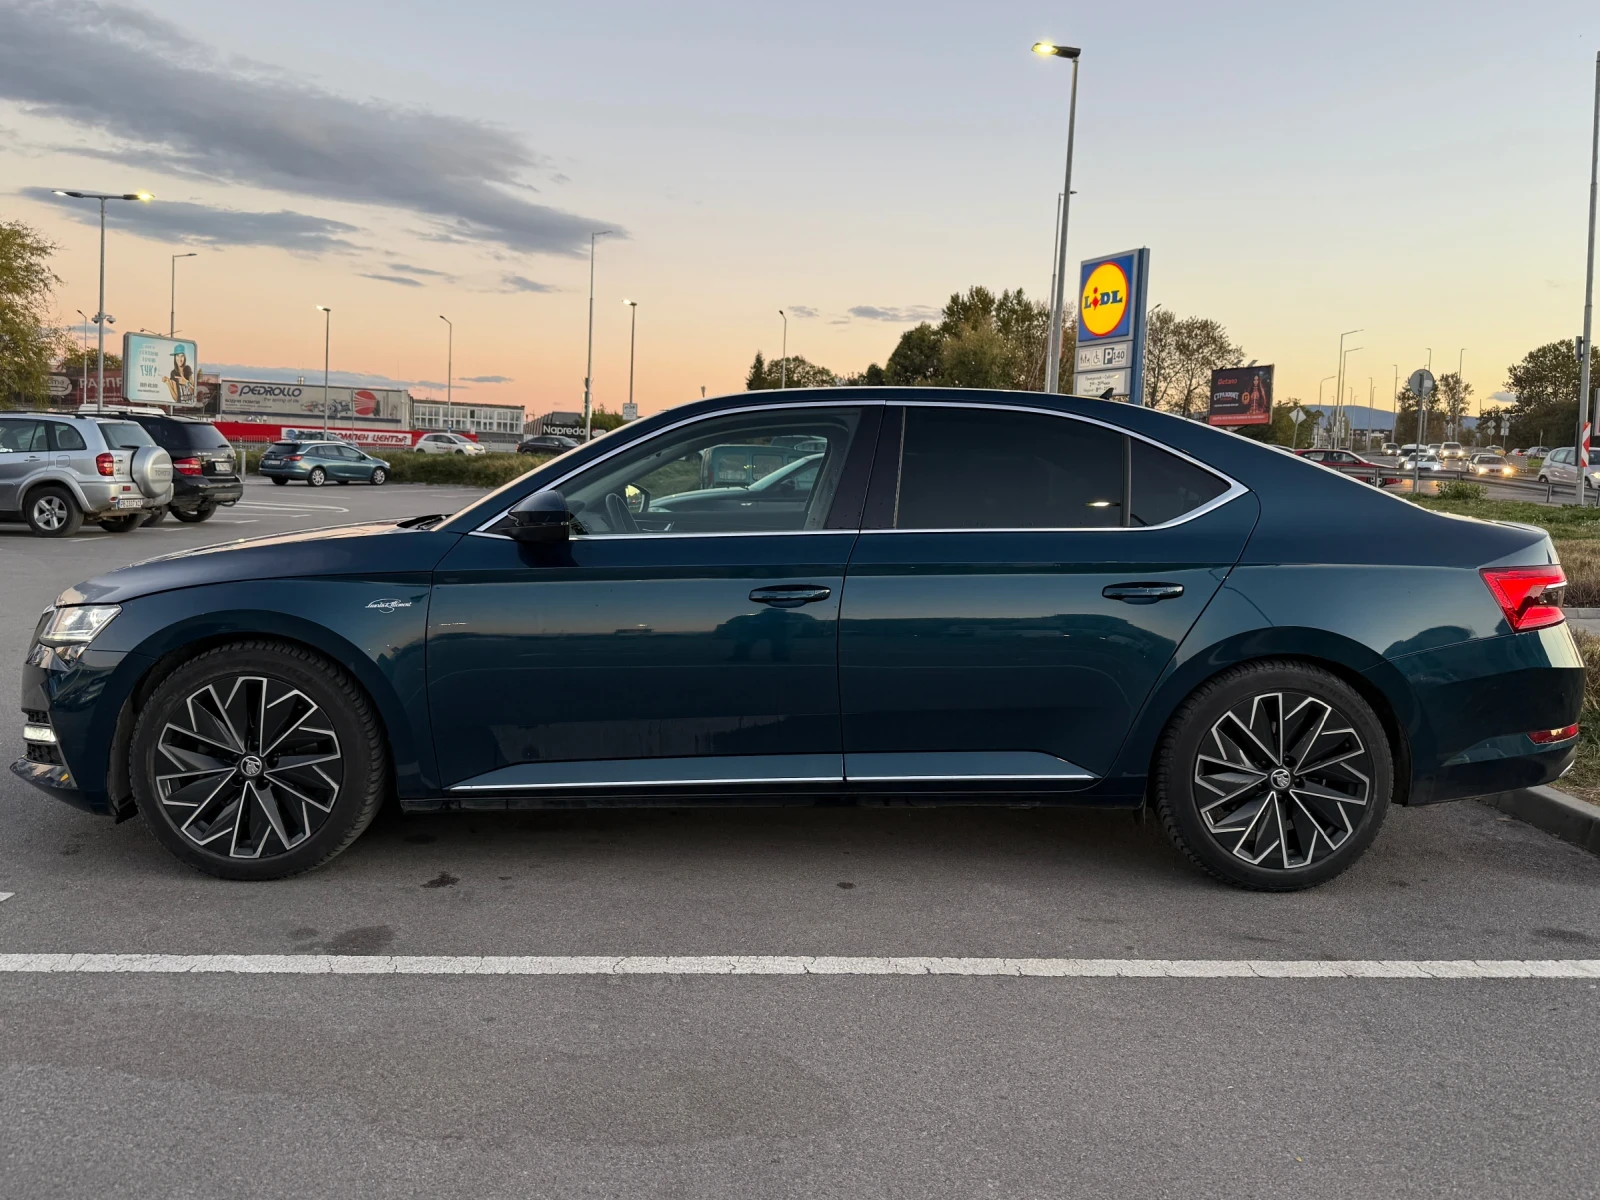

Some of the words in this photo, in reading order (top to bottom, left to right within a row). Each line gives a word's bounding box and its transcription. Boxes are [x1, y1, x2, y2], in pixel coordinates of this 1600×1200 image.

[1104, 348, 1112, 364] P
[1113, 350, 1124, 360] 140
[139, 364, 157, 377] ТУК!
[239, 385, 302, 397] PEDROLLO
[543, 424, 590, 436] Napreda
[372, 434, 408, 443] ЦЕНТЪР
